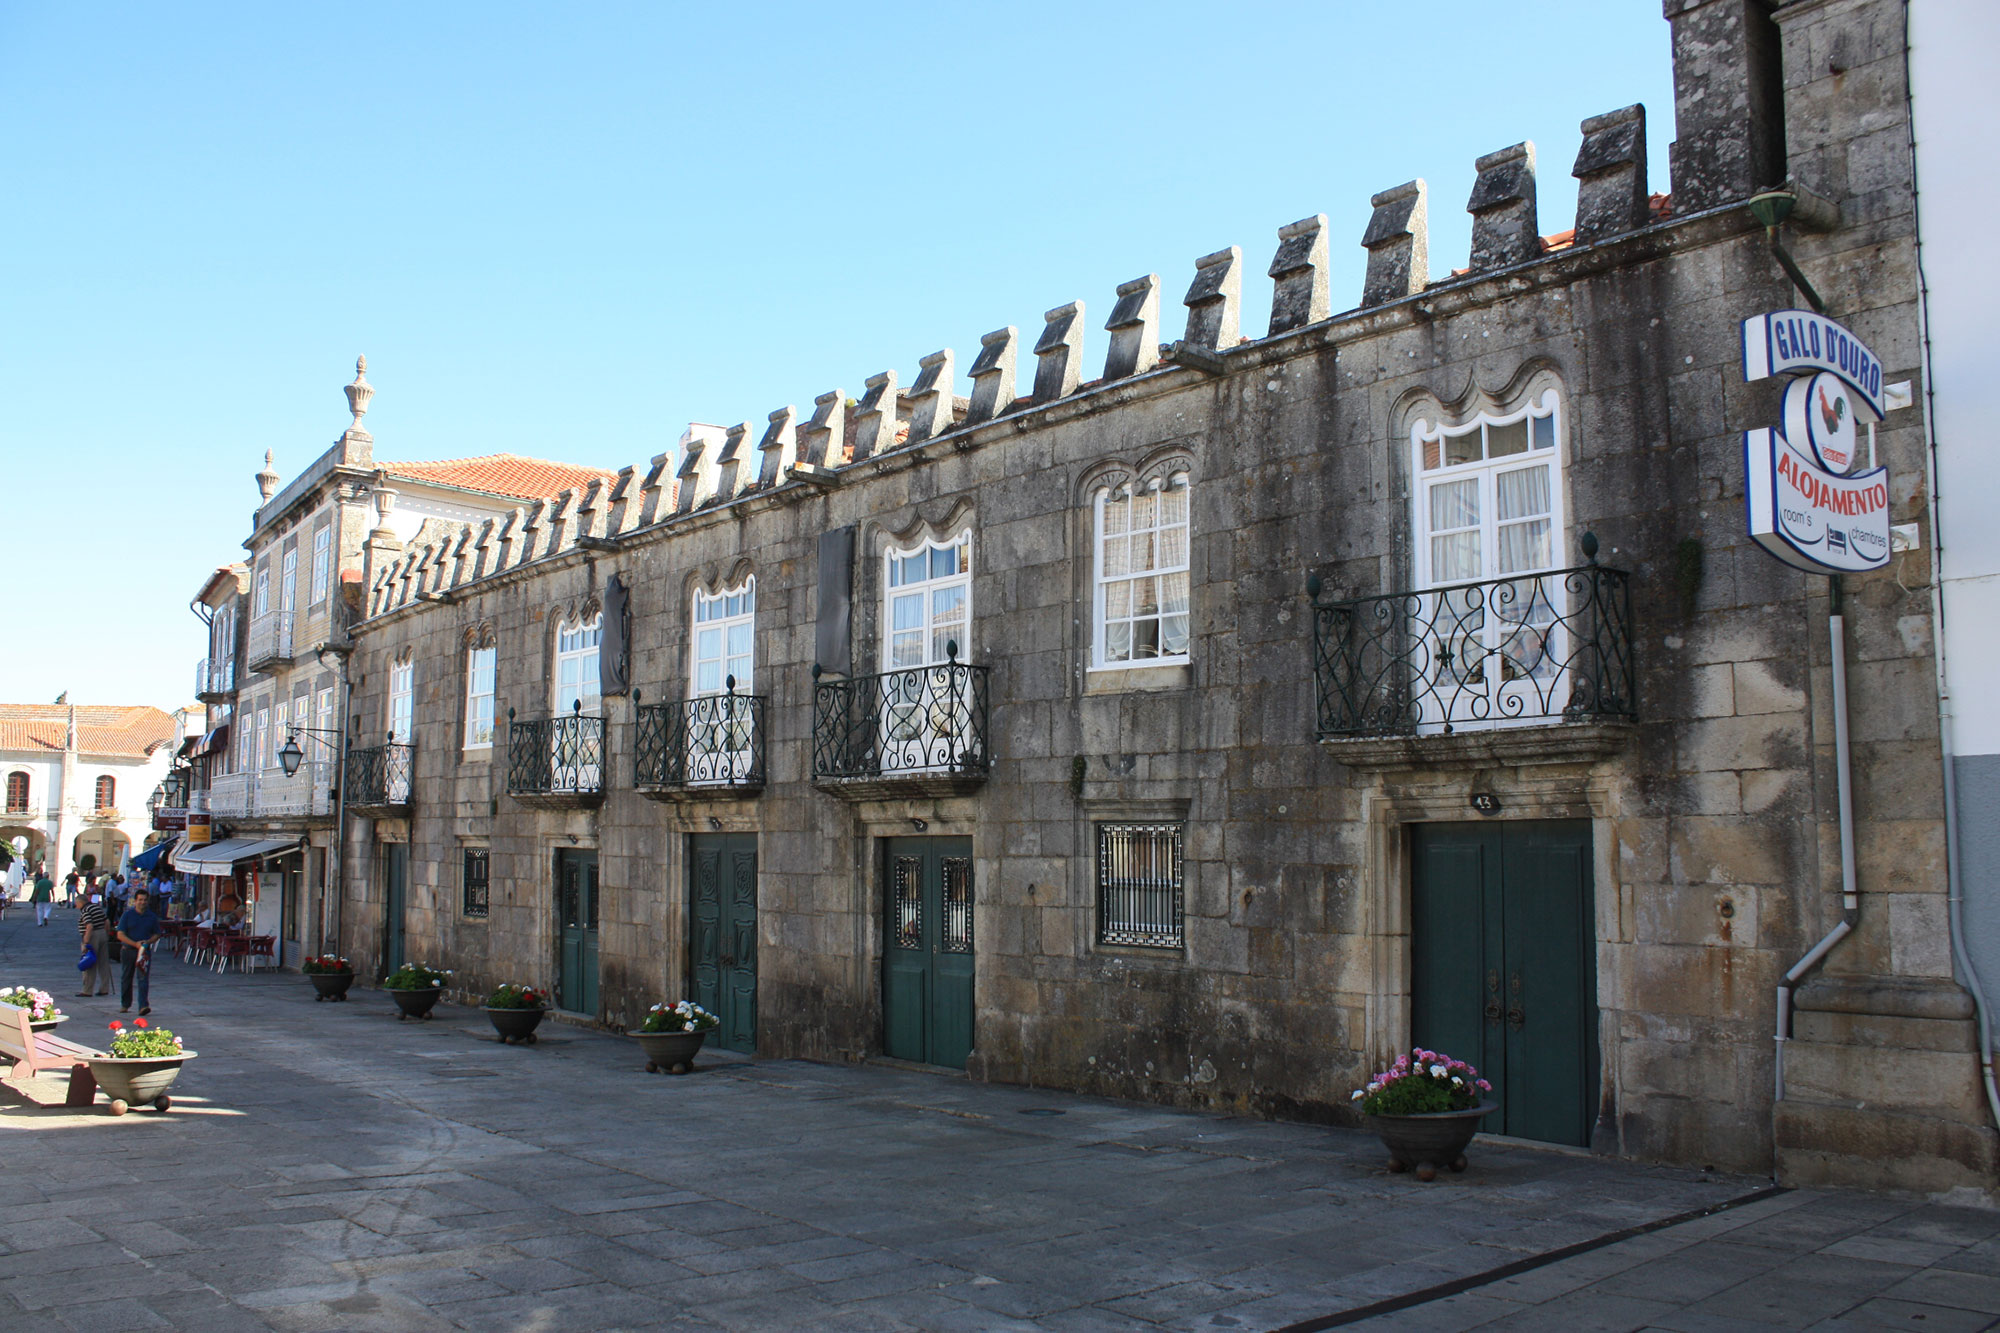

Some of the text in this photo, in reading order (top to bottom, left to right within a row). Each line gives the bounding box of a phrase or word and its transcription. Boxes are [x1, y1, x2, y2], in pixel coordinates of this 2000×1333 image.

[1775, 318, 1880, 398] GALO D'OURO
[1777, 451, 1886, 516] ALOJAMENTO
[1851, 526, 1886, 548] chambres
[1476, 796, 1491, 809] 13
